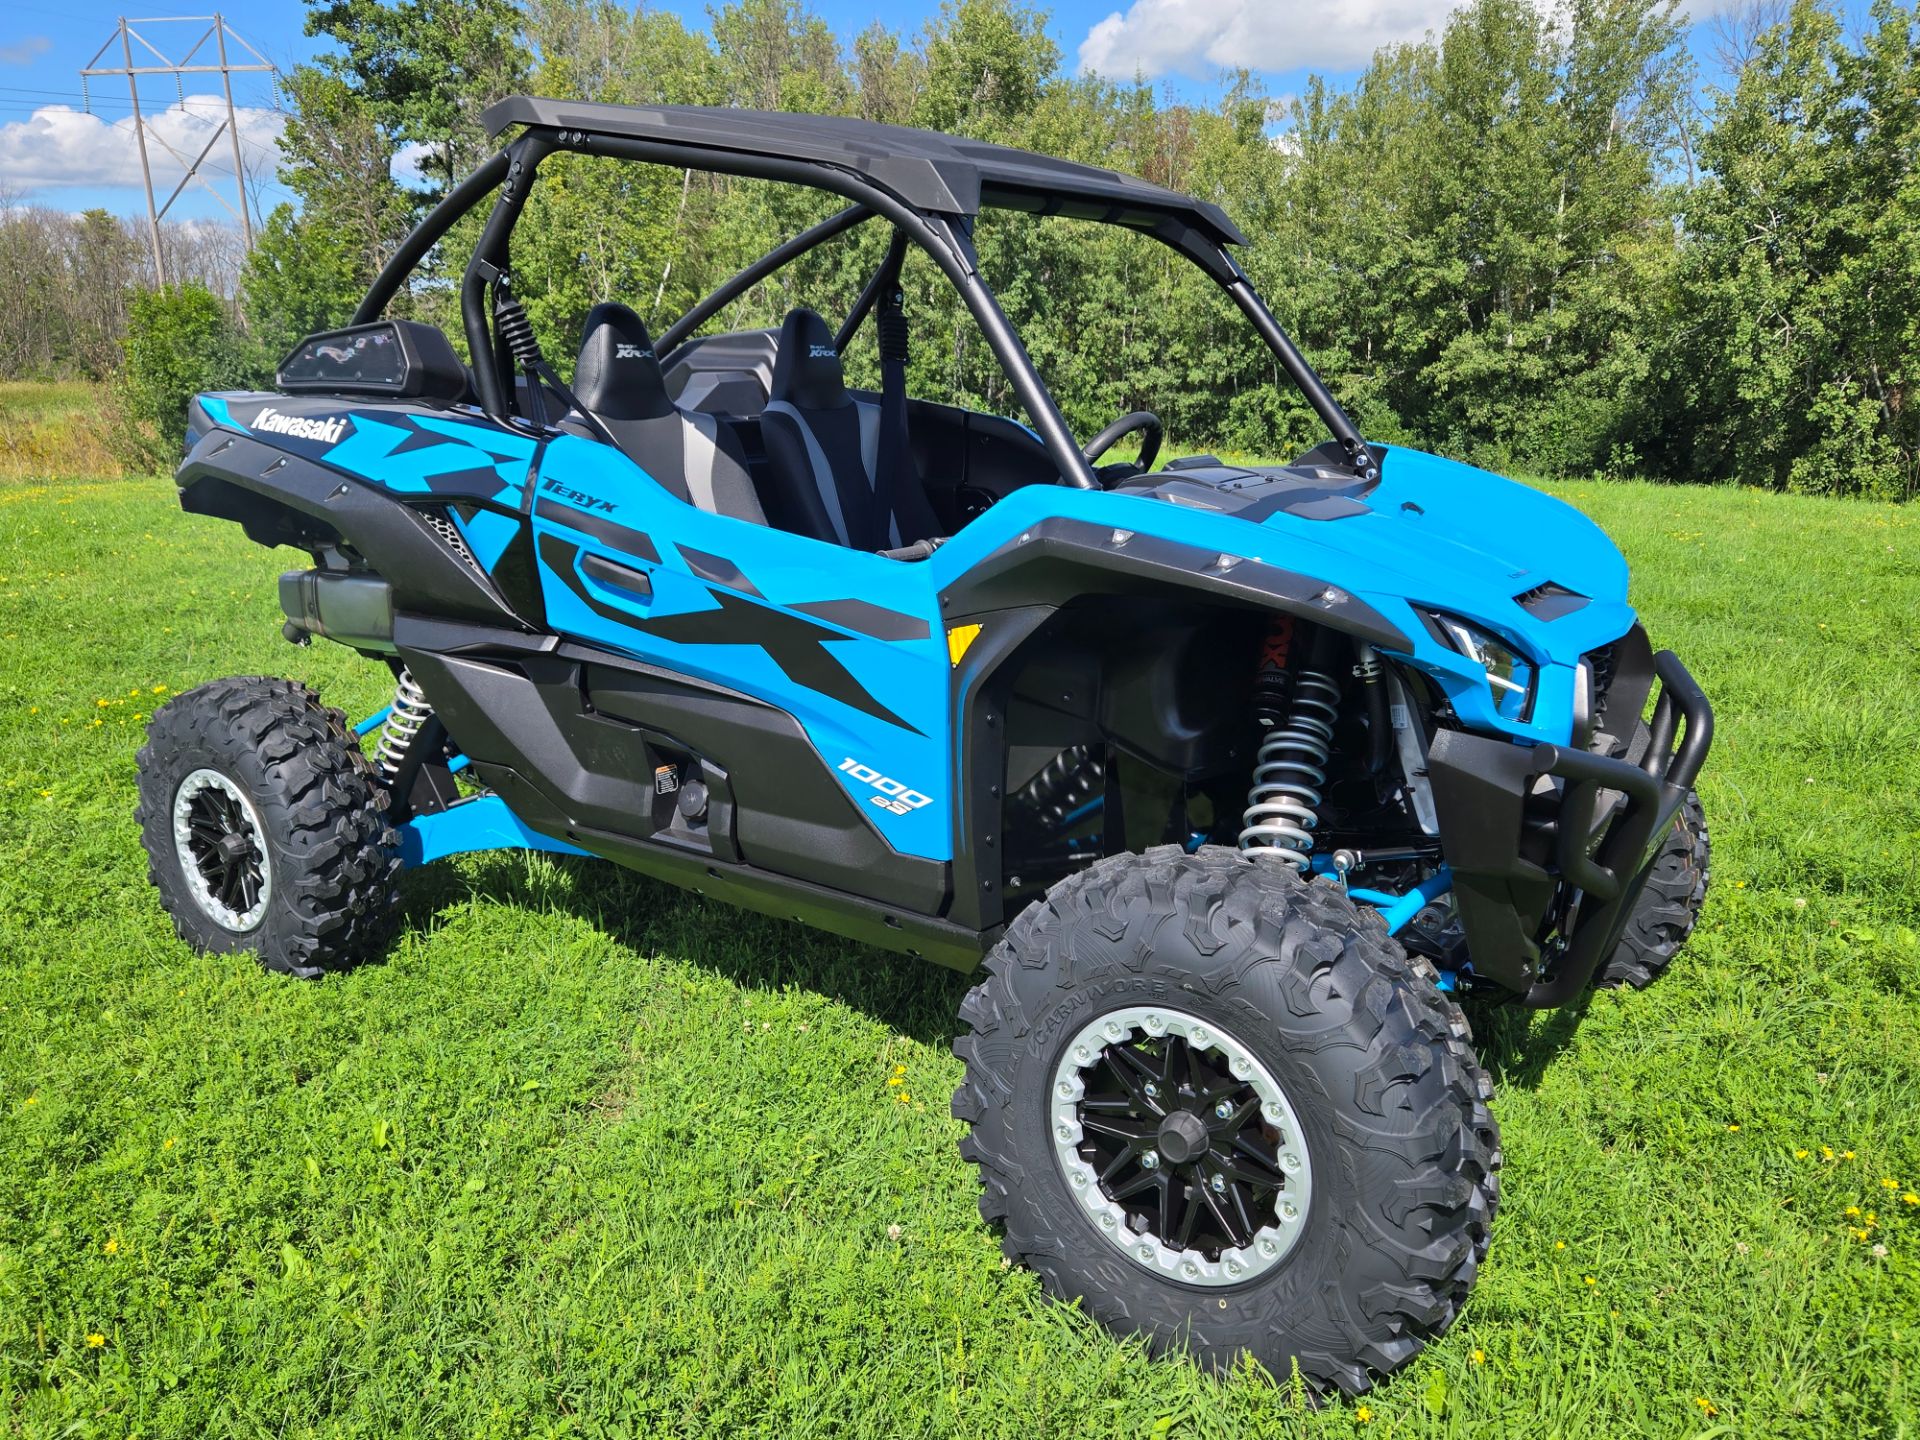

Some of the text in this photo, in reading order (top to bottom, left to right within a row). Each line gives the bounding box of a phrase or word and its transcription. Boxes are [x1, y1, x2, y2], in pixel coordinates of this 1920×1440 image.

[250, 407, 347, 444] Kawasaki
[837, 757, 934, 809] 1000
[1033, 977, 1168, 1046] CARNIVORE
